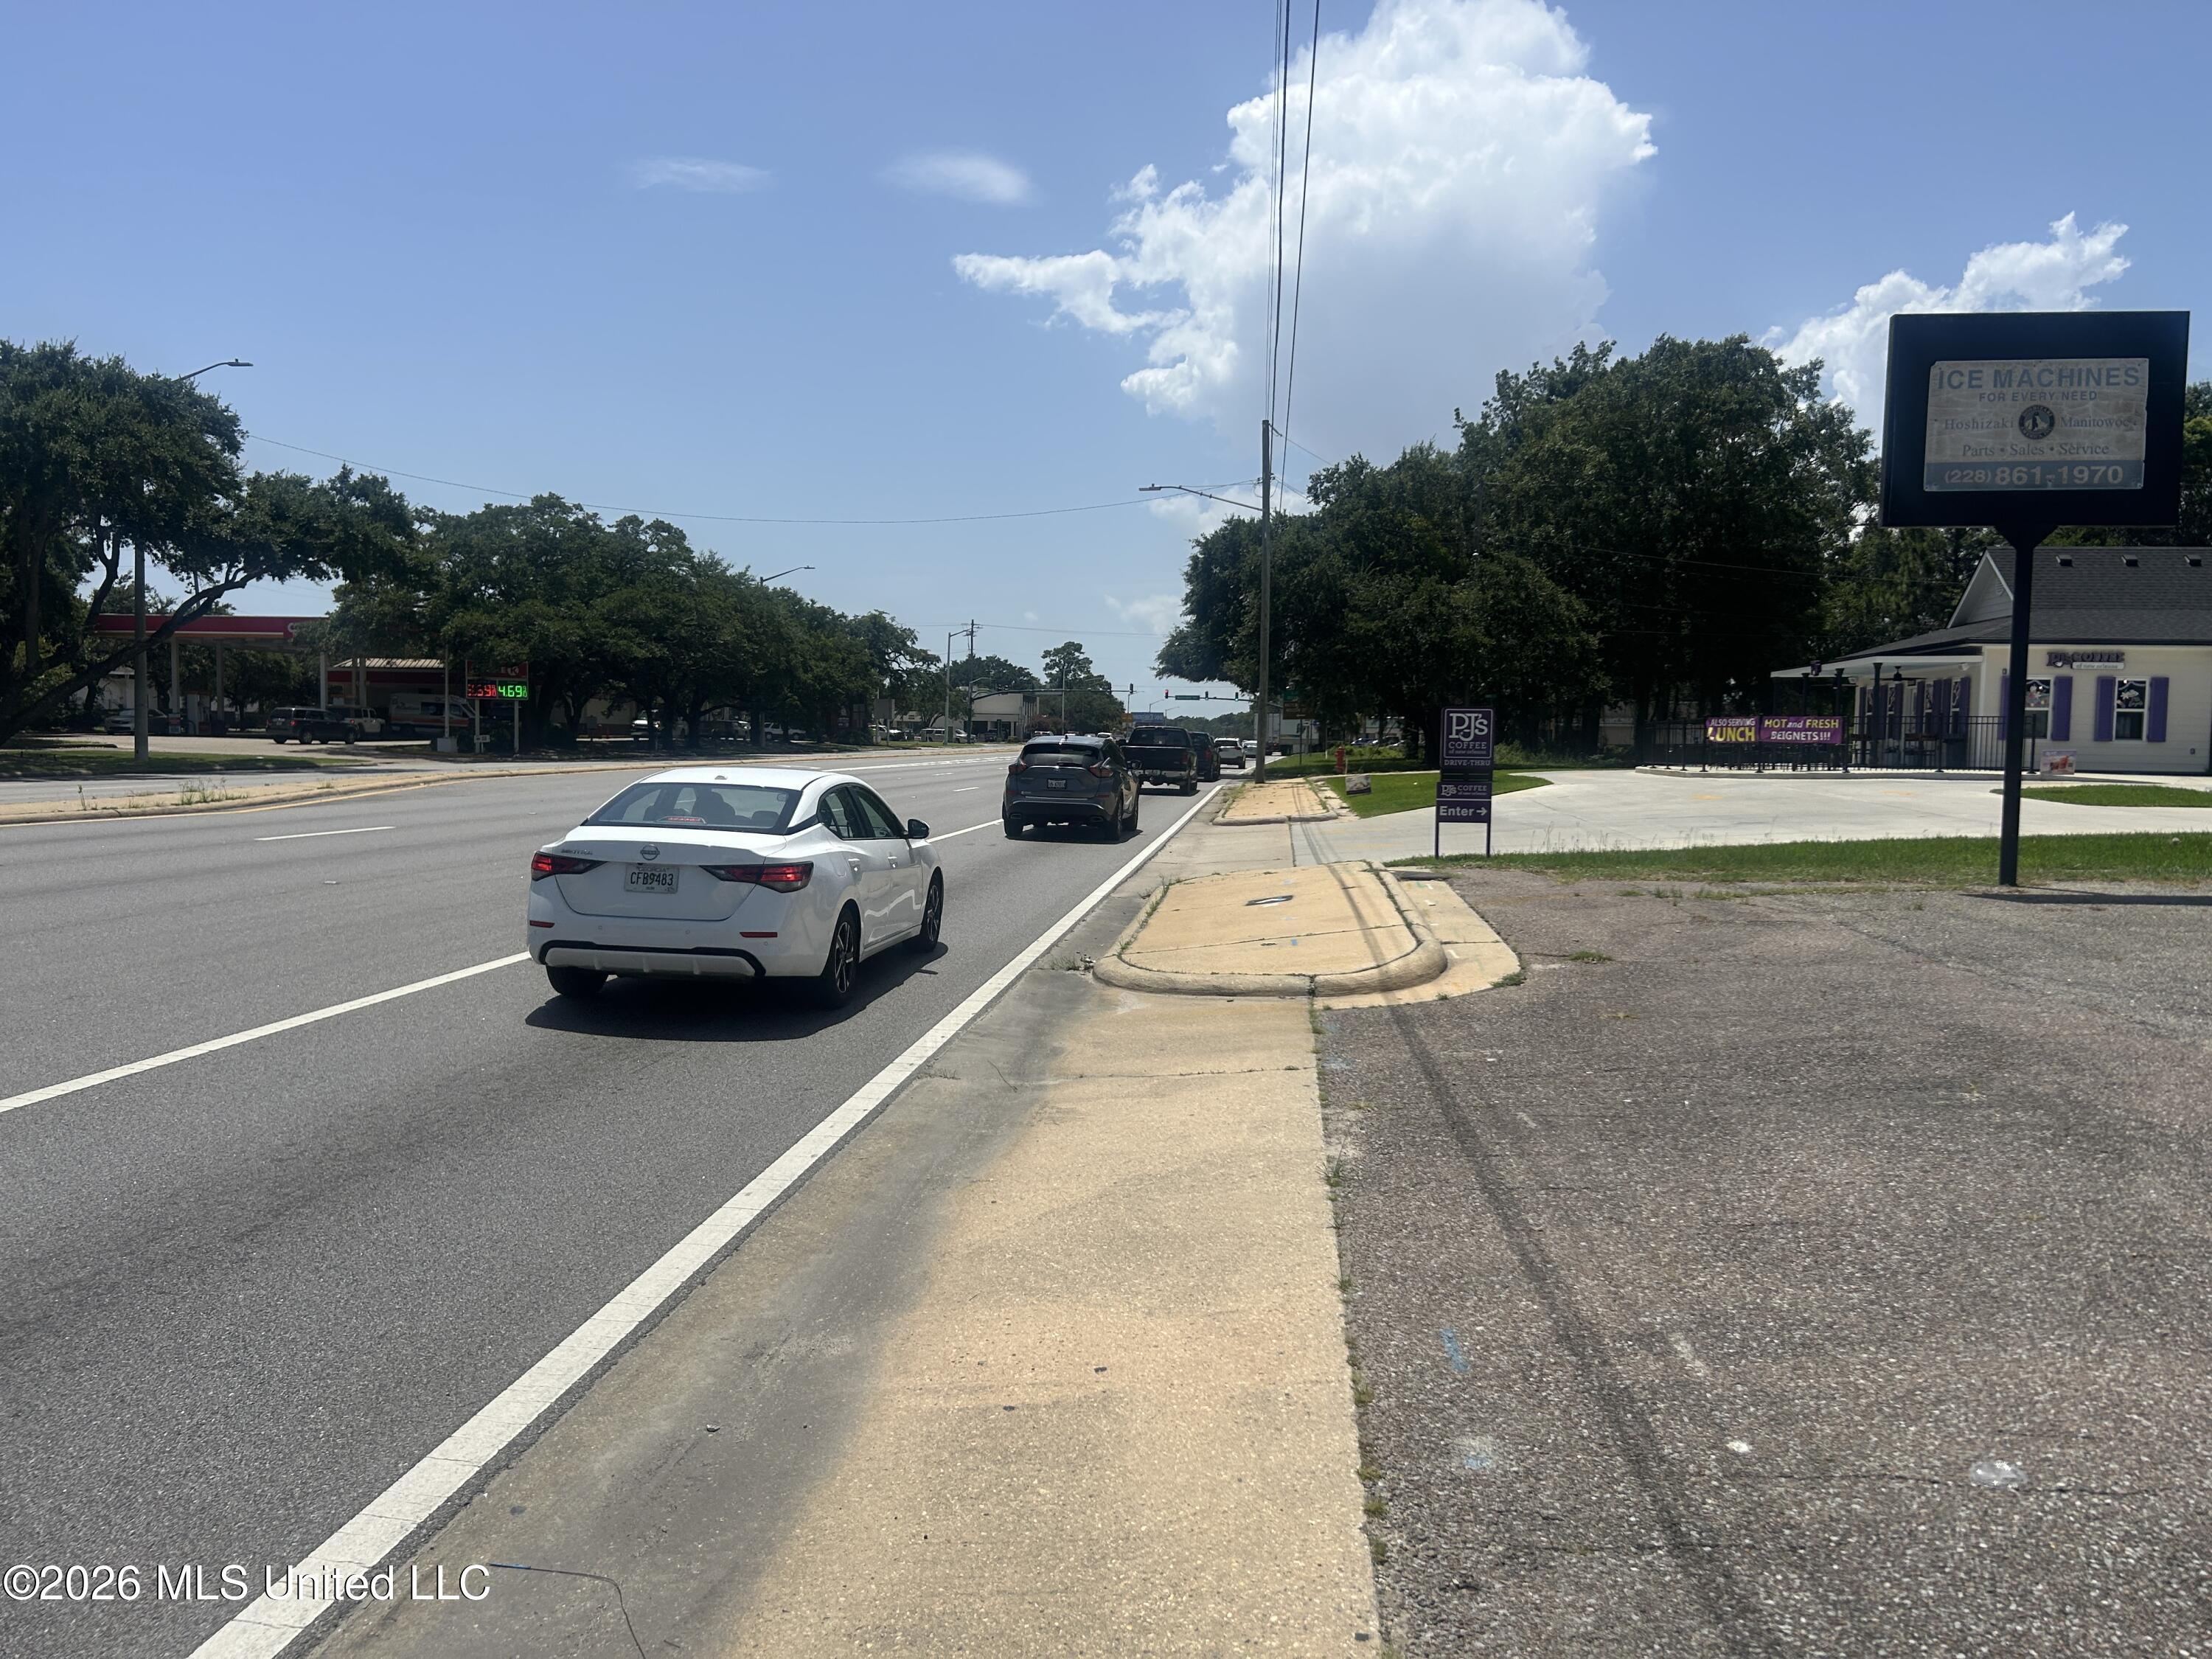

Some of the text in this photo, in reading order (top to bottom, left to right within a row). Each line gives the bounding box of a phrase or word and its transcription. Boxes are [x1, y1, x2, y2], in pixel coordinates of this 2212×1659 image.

[1938, 367, 2139, 389] ICE MACHINES
[1979, 391, 2097, 402] FOR EVERY NEED
[1944, 417, 2014, 430] Hoshizaki
[1962, 442, 2110, 456] Parts Sales Service
[1944, 465, 2124, 485] (228) 861-1970
[1728, 718, 1756, 727] SERVING
[1764, 719, 1839, 728] HOT and FRESH
[1707, 727, 1756, 742] LUNCH
[1439, 806, 1474, 816] Enter
[630, 872, 674, 886] CFB9483
